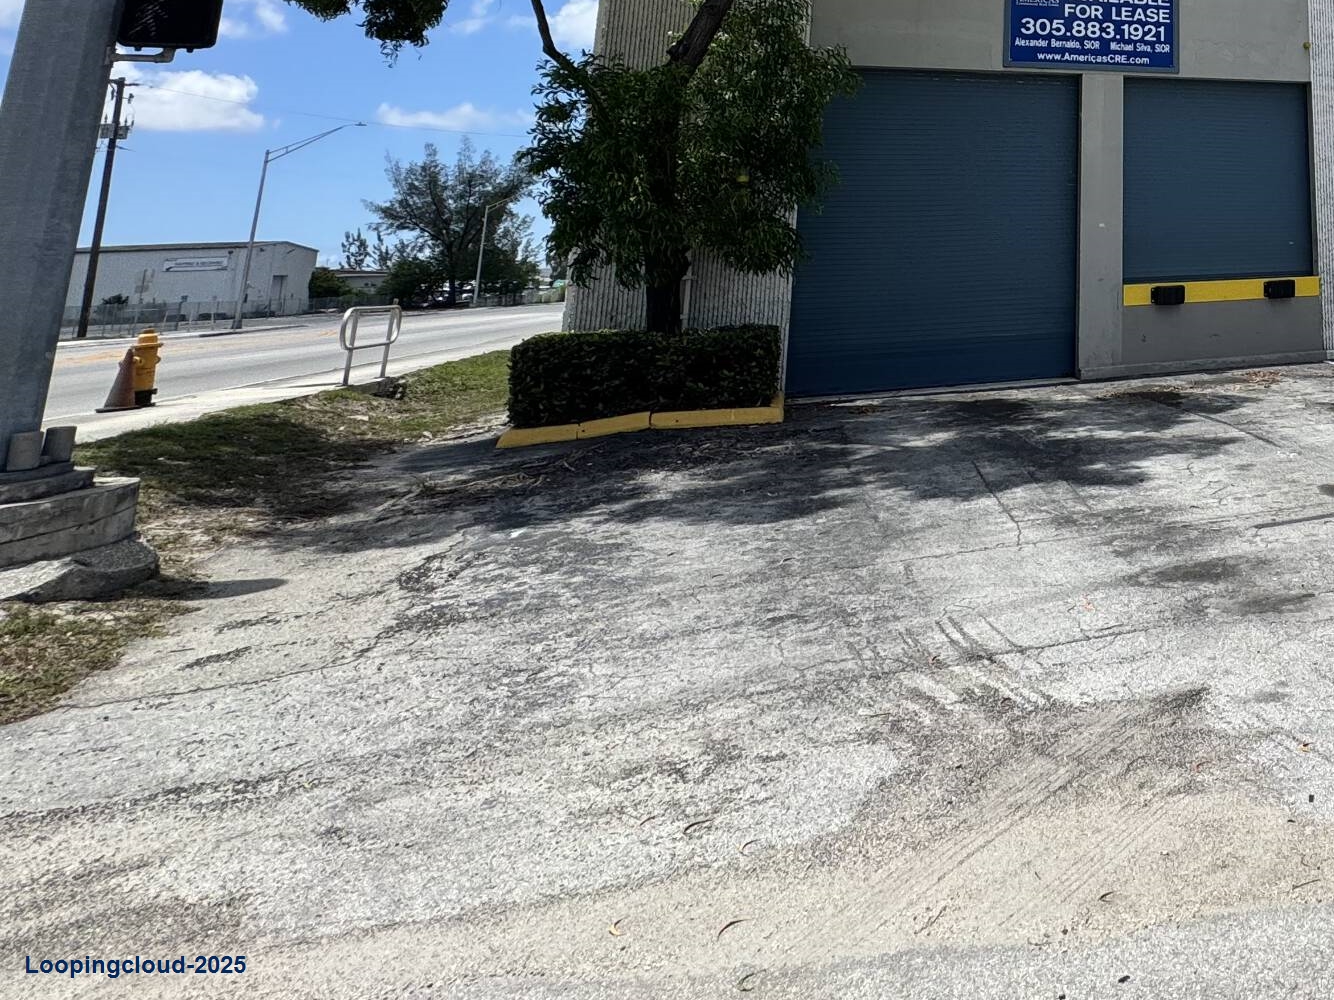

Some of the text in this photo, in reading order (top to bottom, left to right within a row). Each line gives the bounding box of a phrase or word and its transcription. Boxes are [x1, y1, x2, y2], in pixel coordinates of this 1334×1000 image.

[1064, 3, 1171, 23] FOR LEASE
[1020, 17, 1165, 41] 305.883.1921
[1014, 37, 1049, 47] Alexander
[1083, 40, 1101, 50] SIOR
[1110, 41, 1134, 51] Michael
[1154, 44, 1170, 53] SIOR
